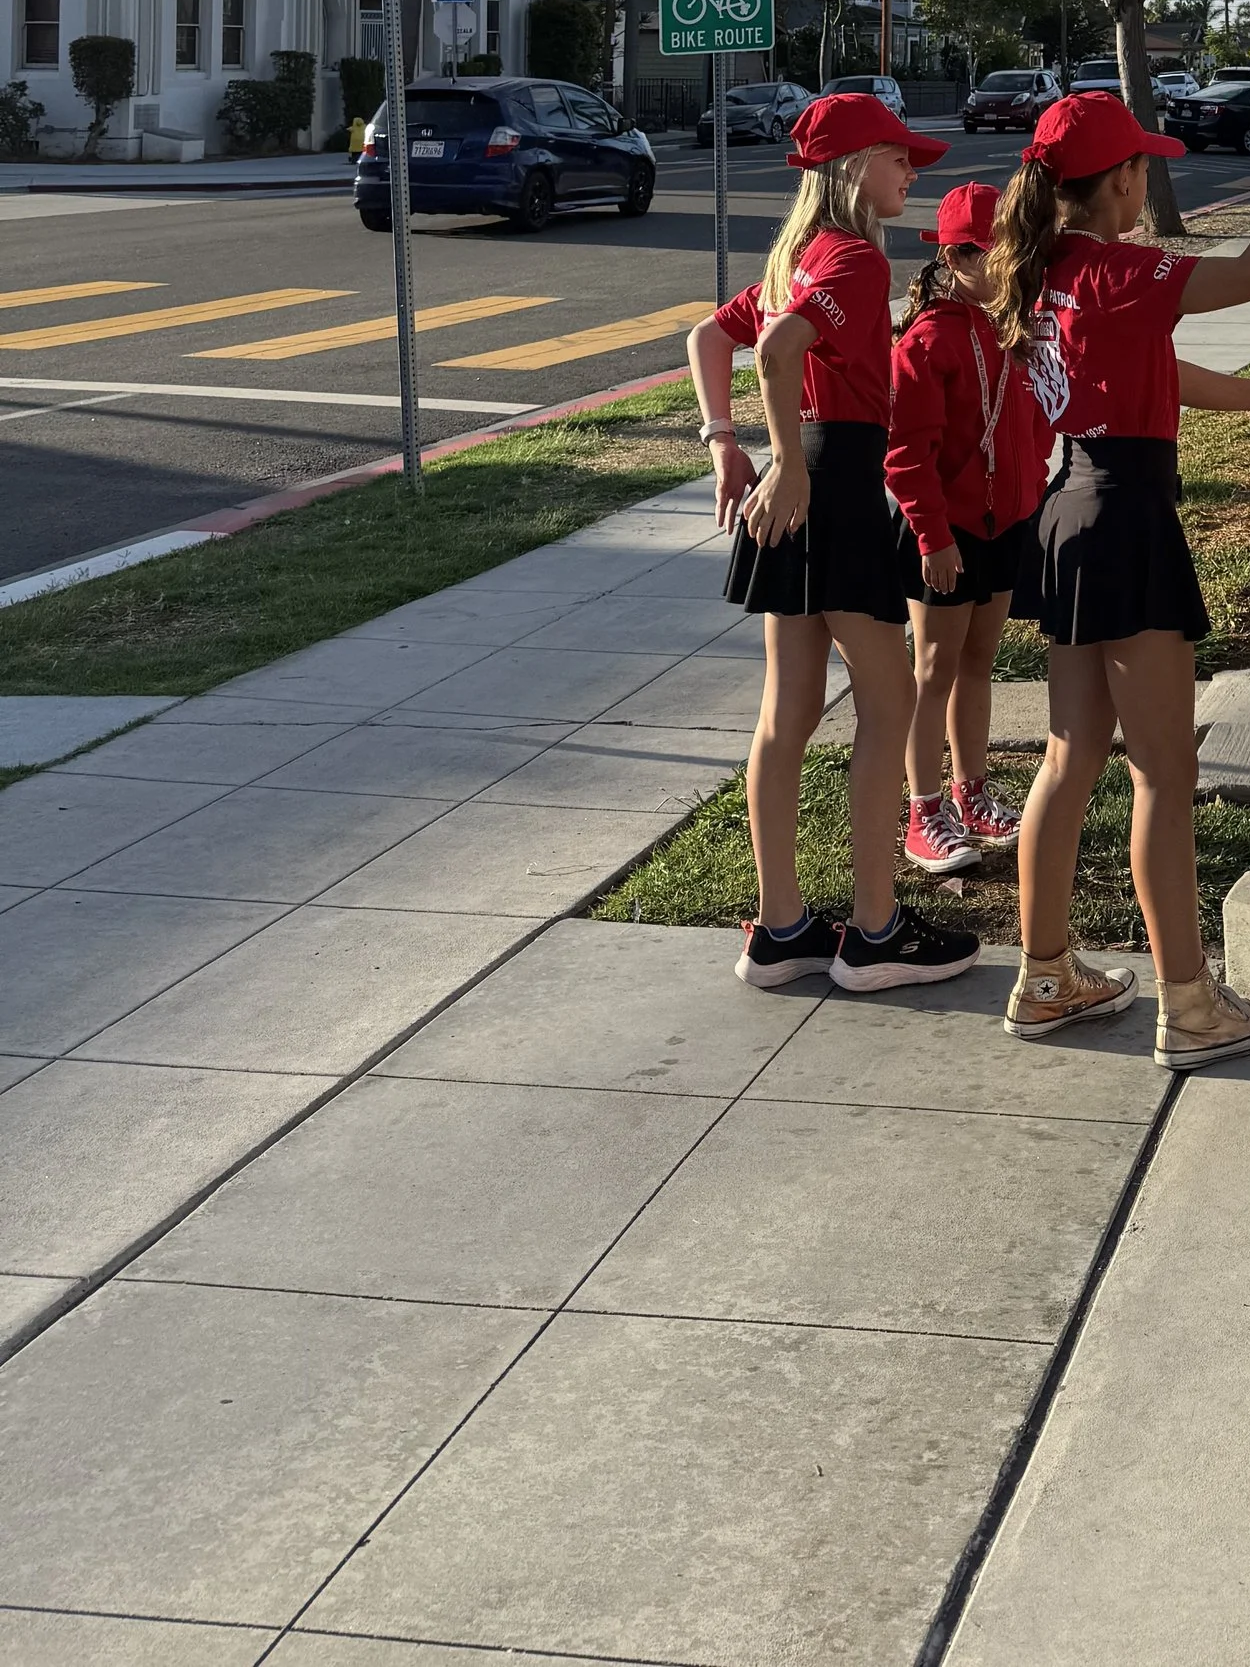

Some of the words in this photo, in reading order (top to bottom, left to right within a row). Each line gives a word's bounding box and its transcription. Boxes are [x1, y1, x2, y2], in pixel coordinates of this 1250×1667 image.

[671, 30, 706, 49] BIKE
[714, 27, 764, 46] ROUTE
[811, 289, 846, 326] SDPD
[1049, 289, 1081, 310] PATROL
